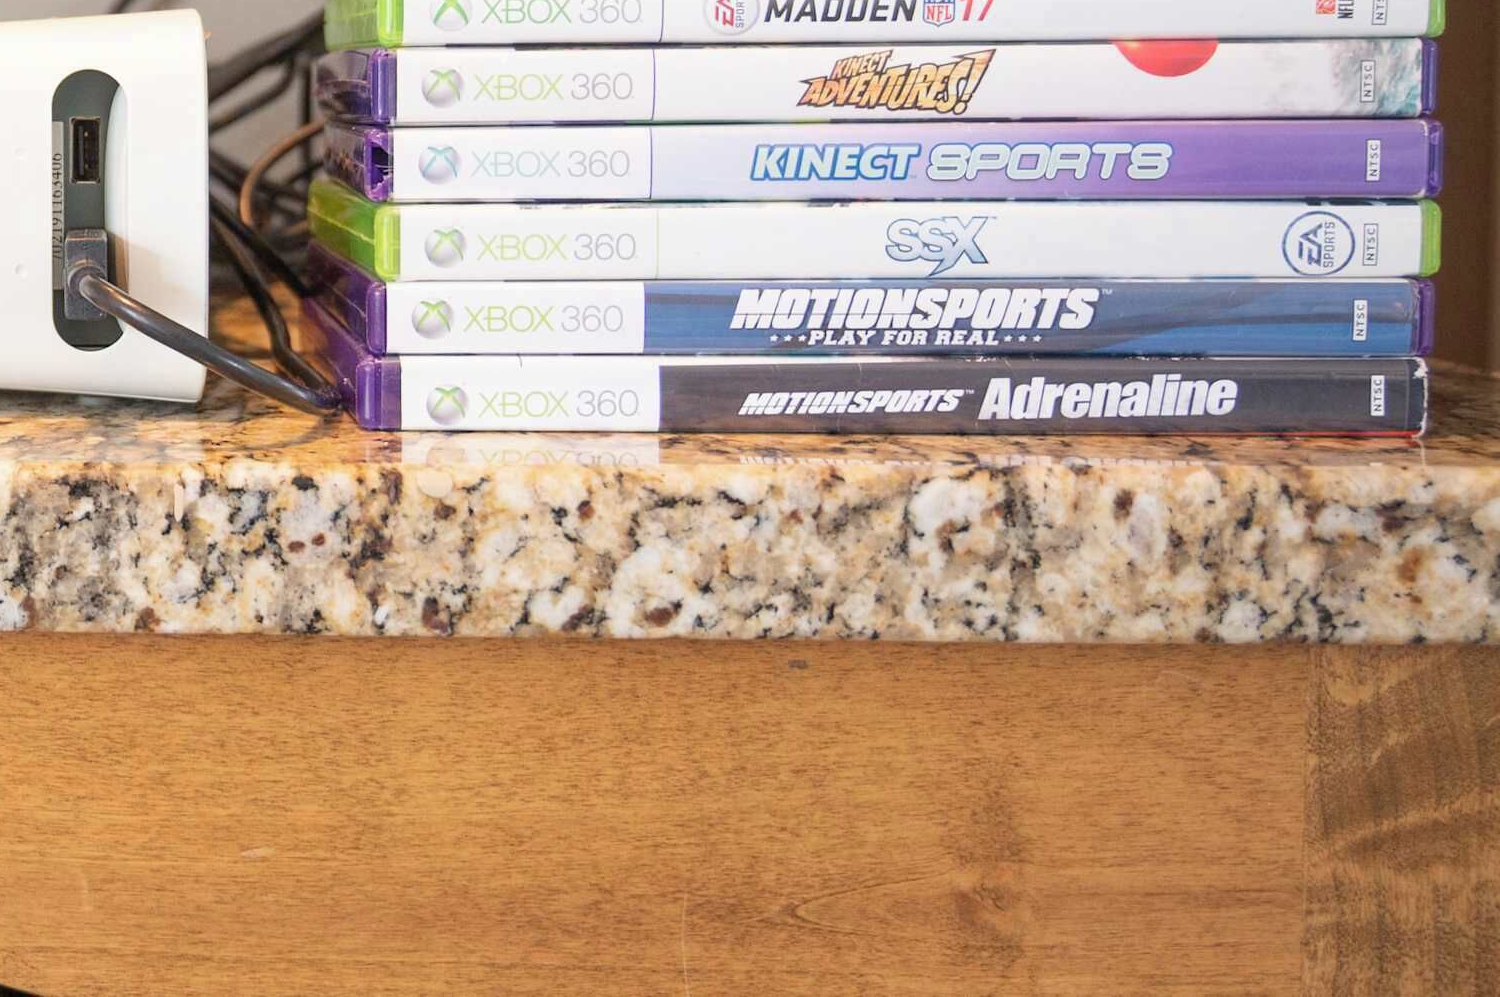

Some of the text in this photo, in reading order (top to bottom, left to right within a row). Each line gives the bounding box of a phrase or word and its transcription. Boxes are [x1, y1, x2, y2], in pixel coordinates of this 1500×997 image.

[926, 6, 953, 22] NFL
[797, 49, 997, 115] ADVENTURES!
[831, 50, 893, 79] KINECT
[1363, 63, 1373, 99] NTSC
[473, 73, 633, 101] XBOX 360
[470, 150, 630, 178] XBOX 360
[750, 141, 1173, 181] KINECT SPORTS
[1368, 142, 1378, 178] NTSC
[476, 233, 636, 261] XBOX 360
[885, 216, 989, 277] SSX
[1323, 220, 1336, 269] SPORTS
[1365, 227, 1376, 262] NTSC
[464, 305, 624, 333] XBOX 360
[1356, 302, 1366, 338] NTSC
[808, 330, 999, 346] PLAY FOR REAL
[478, 390, 639, 418] XBOX 360
[977, 373, 1239, 420] Adrenaline
[1373, 377, 1383, 413] NTSC
